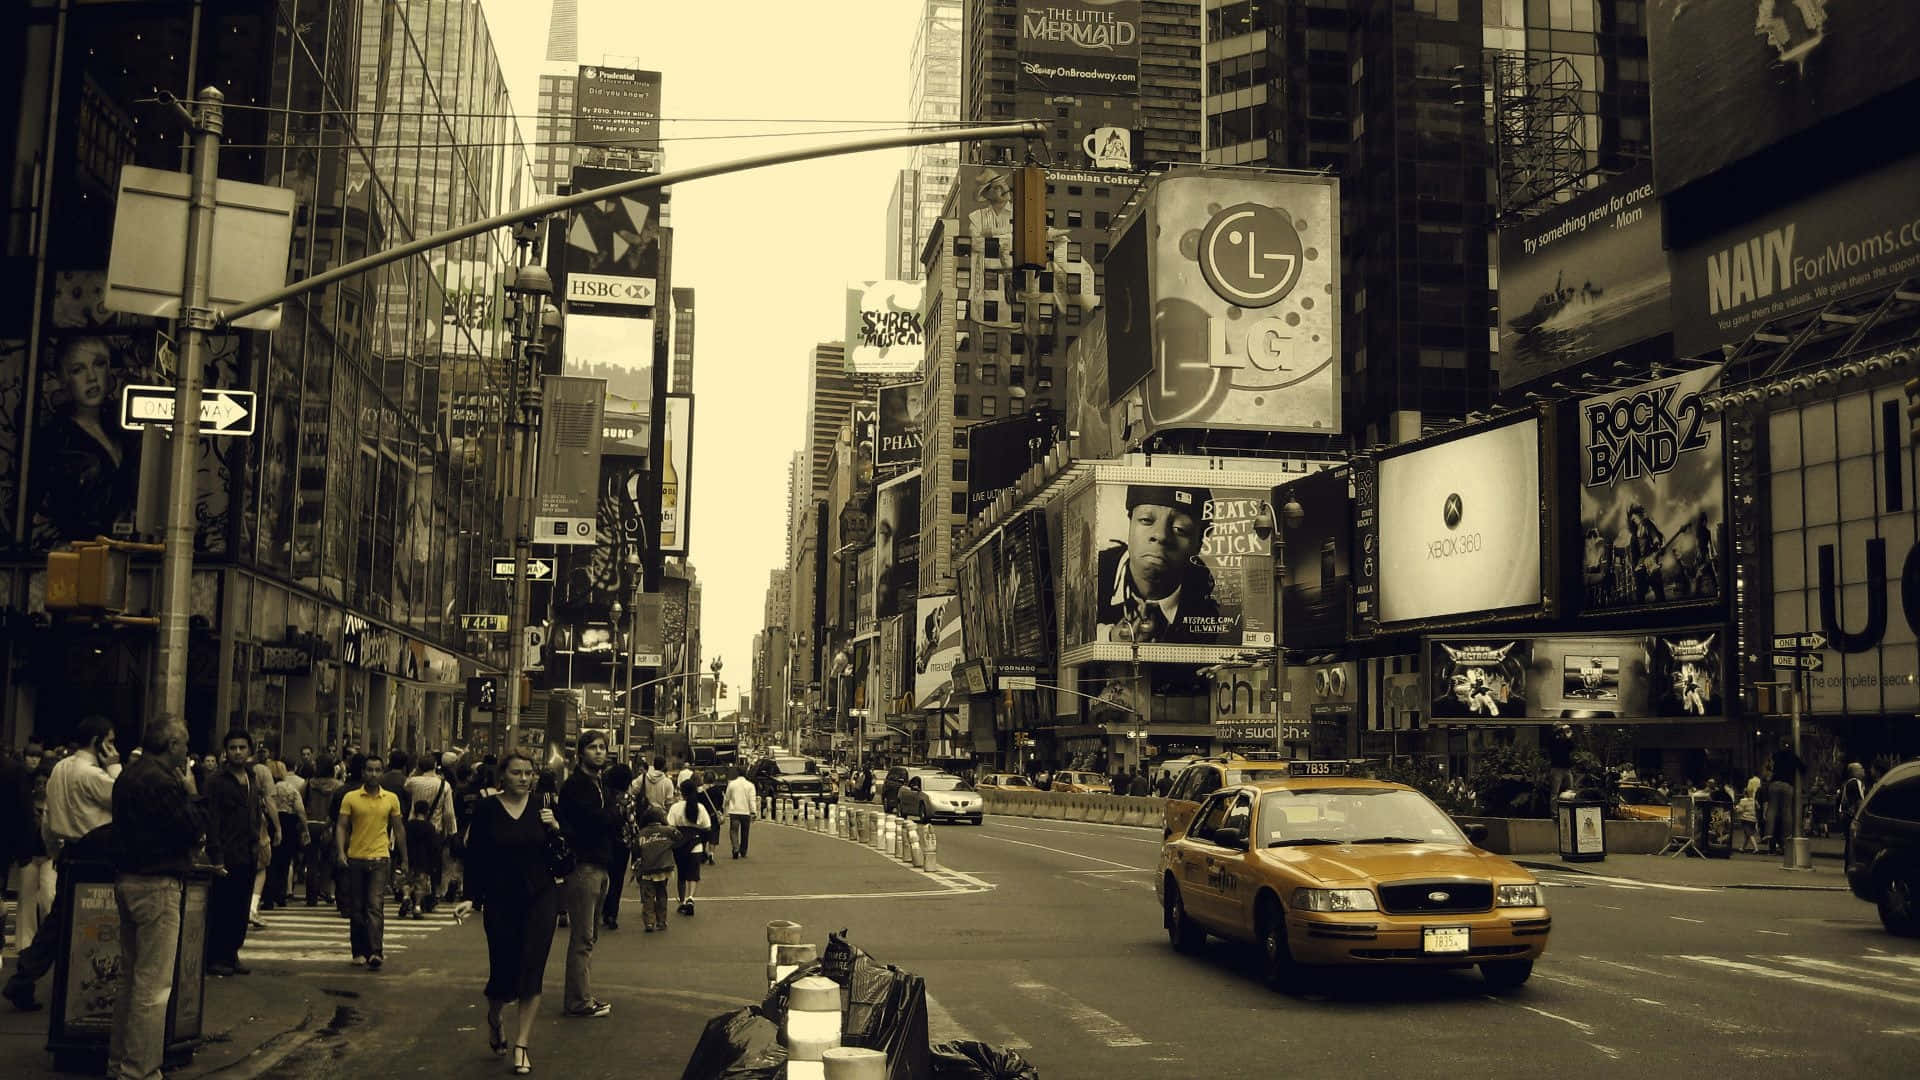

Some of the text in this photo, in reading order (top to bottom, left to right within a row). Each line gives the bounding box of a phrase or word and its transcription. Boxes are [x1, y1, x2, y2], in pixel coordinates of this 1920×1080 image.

[1047, 7, 1115, 24] THE LITTLE
[1023, 15, 1136, 51] MERMAID
[599, 70, 635, 81] Prudential
[1021, 61, 1136, 83] DisneyOnBroadway.com
[589, 87, 603, 95] Did
[605, 89, 620, 97] you
[1045, 170, 1140, 185] Colombian Coffee
[1523, 183, 1654, 254] Try something new for once.
[1616, 207, 1642, 230] Mom
[572, 280, 622, 298] HSBC
[861, 311, 922, 334] SHREK
[864, 332, 922, 348] MUSICAL
[1585, 382, 1681, 448] ROCK
[1677, 391, 1711, 453] 2
[1585, 430, 1680, 488] BAND
[1201, 500, 1259, 521] BEATS
[1209, 522, 1247, 536] THAT
[1201, 533, 1264, 555] STICK
[1427, 532, 1482, 560] XBOX 360
[461, 615, 470, 629] W
[473, 615, 488, 629] 44
[1779, 637, 1820, 647] ONE WAY
[999, 664, 1036, 672] VORNADO
[1777, 656, 1817, 666] ONE WAY
[1305, 763, 1330, 775] 7B35
